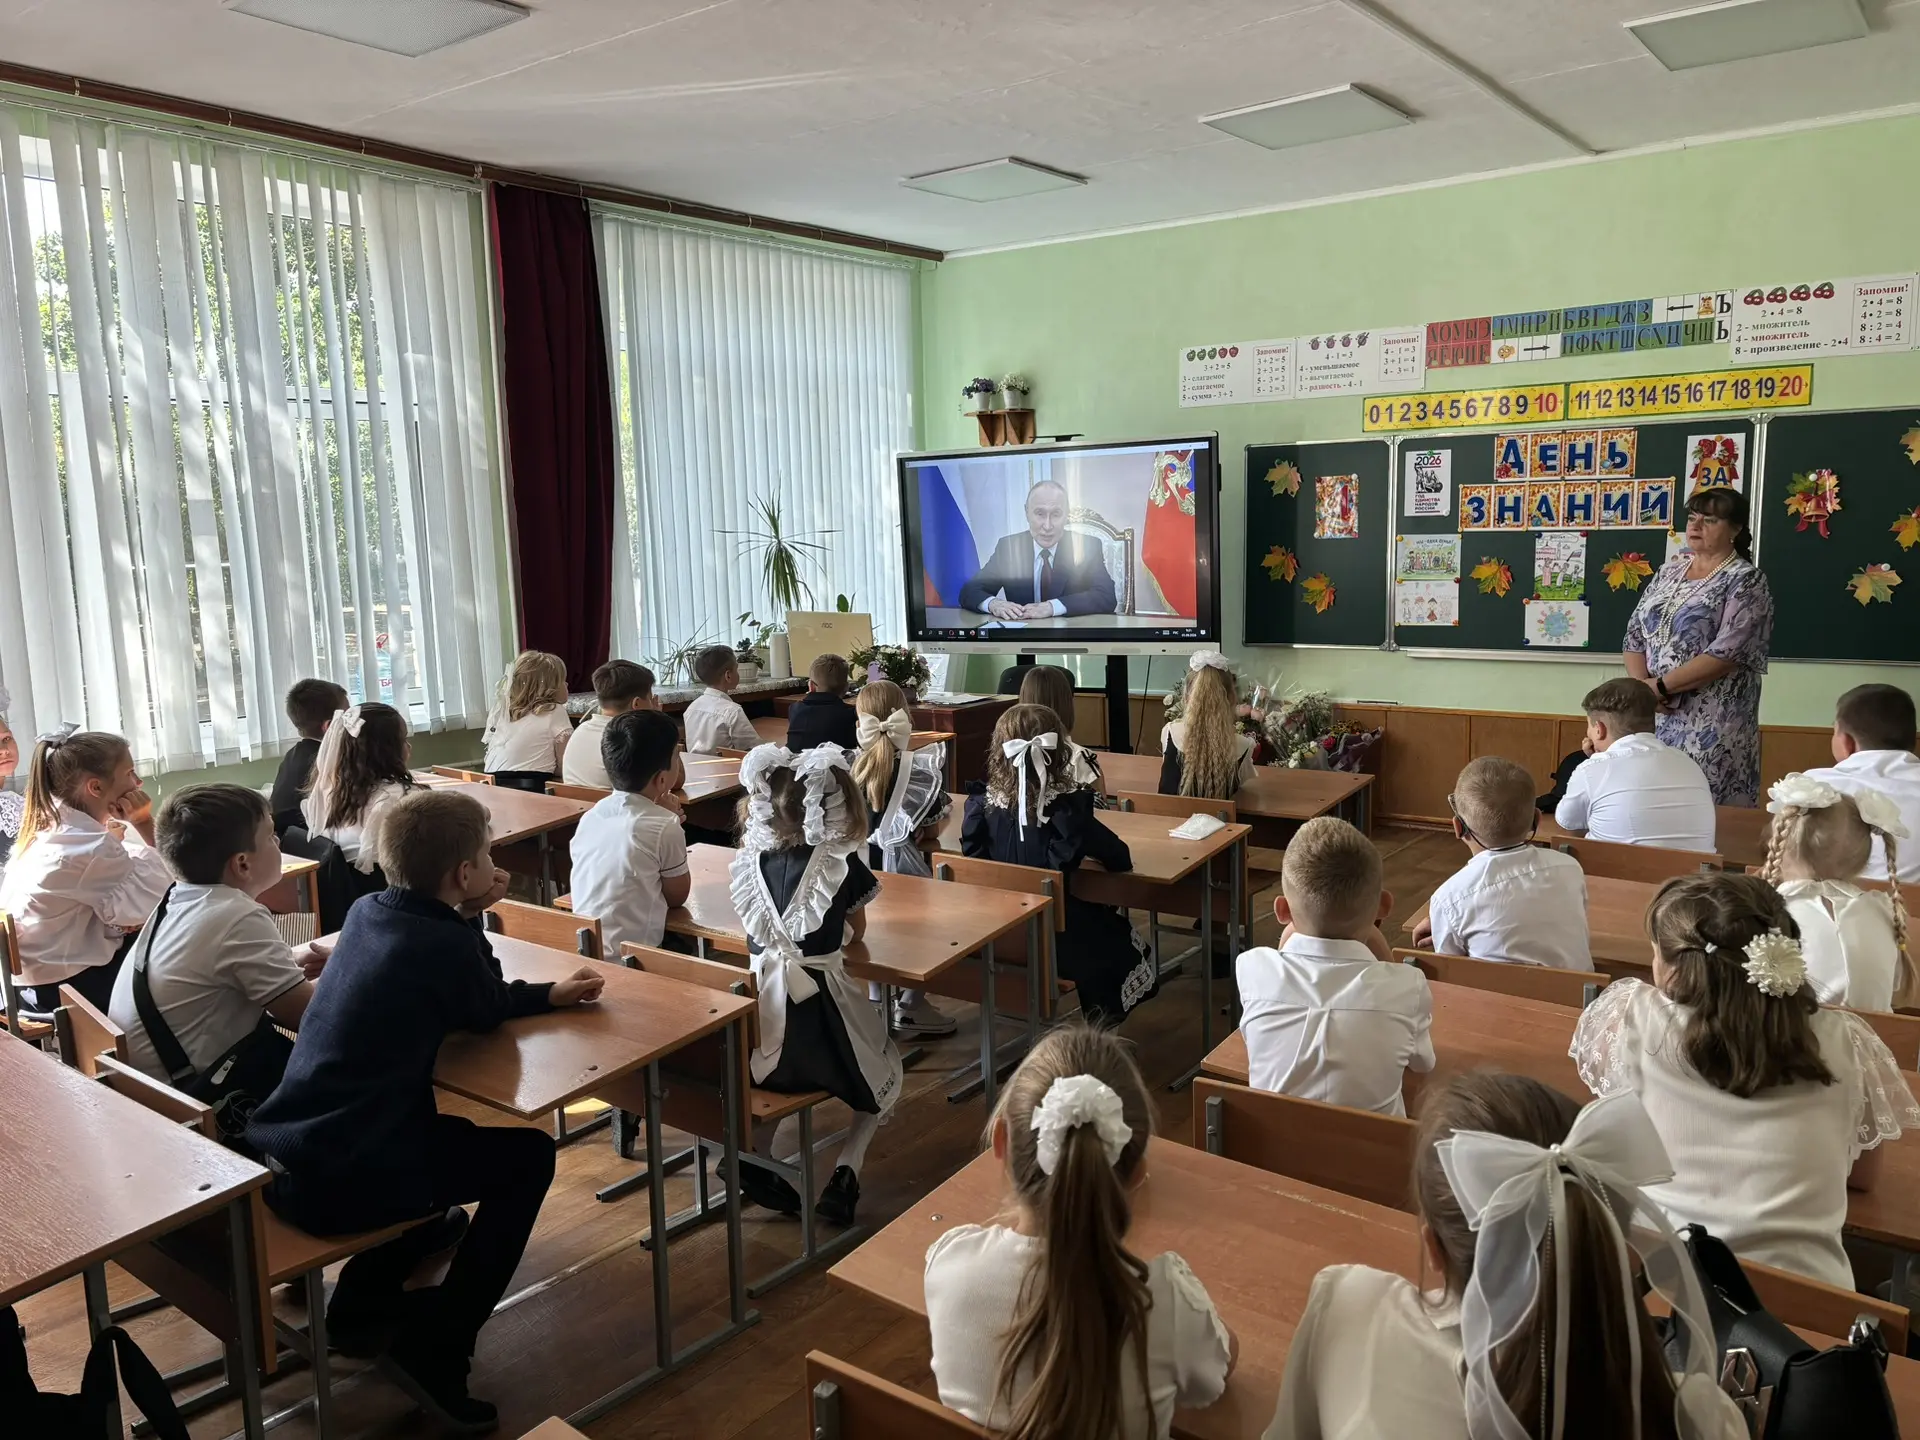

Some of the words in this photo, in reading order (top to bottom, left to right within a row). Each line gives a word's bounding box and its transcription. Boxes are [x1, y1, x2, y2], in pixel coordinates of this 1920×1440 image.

[1856, 284, 1908, 296] Запомни!
[1717, 294, 1731, 314] Ъ
[1716, 320, 1729, 340] Ь
[1752, 320, 1810, 330] множитель
[1383, 336, 1420, 345] Запомни!
[1751, 332, 1810, 342] множитель
[1750, 342, 1821, 355] произведение
[1192, 393, 1212, 401] сумма
[1575, 390, 1590, 410] 11
[1595, 389, 1612, 409] 12
[1617, 387, 1634, 407] 13
[1639, 386, 1657, 406] 14
[1662, 384, 1680, 404] 15
[1685, 382, 1703, 403] 16
[1708, 380, 1726, 401] 17
[1731, 379, 1750, 399] 18
[1756, 377, 1775, 398] 19
[1779, 376, 1802, 397] 20
[1370, 405, 1380, 423] 0
[1386, 404, 1393, 422] 1
[1400, 403, 1410, 421] 2
[1416, 402, 1427, 420] 3
[1432, 400, 1444, 419] 4
[1450, 400, 1460, 418] 5
[1466, 398, 1477, 418] 6
[1482, 397, 1494, 416] 7
[1499, 396, 1510, 416] 8
[1516, 395, 1528, 414] 9
[1535, 393, 1557, 413] 10
[1416, 456, 1441, 465] 2026
[1501, 439, 1628, 474] ДЕНЬ
[1467, 485, 1668, 523] ЗНАНИЙ
